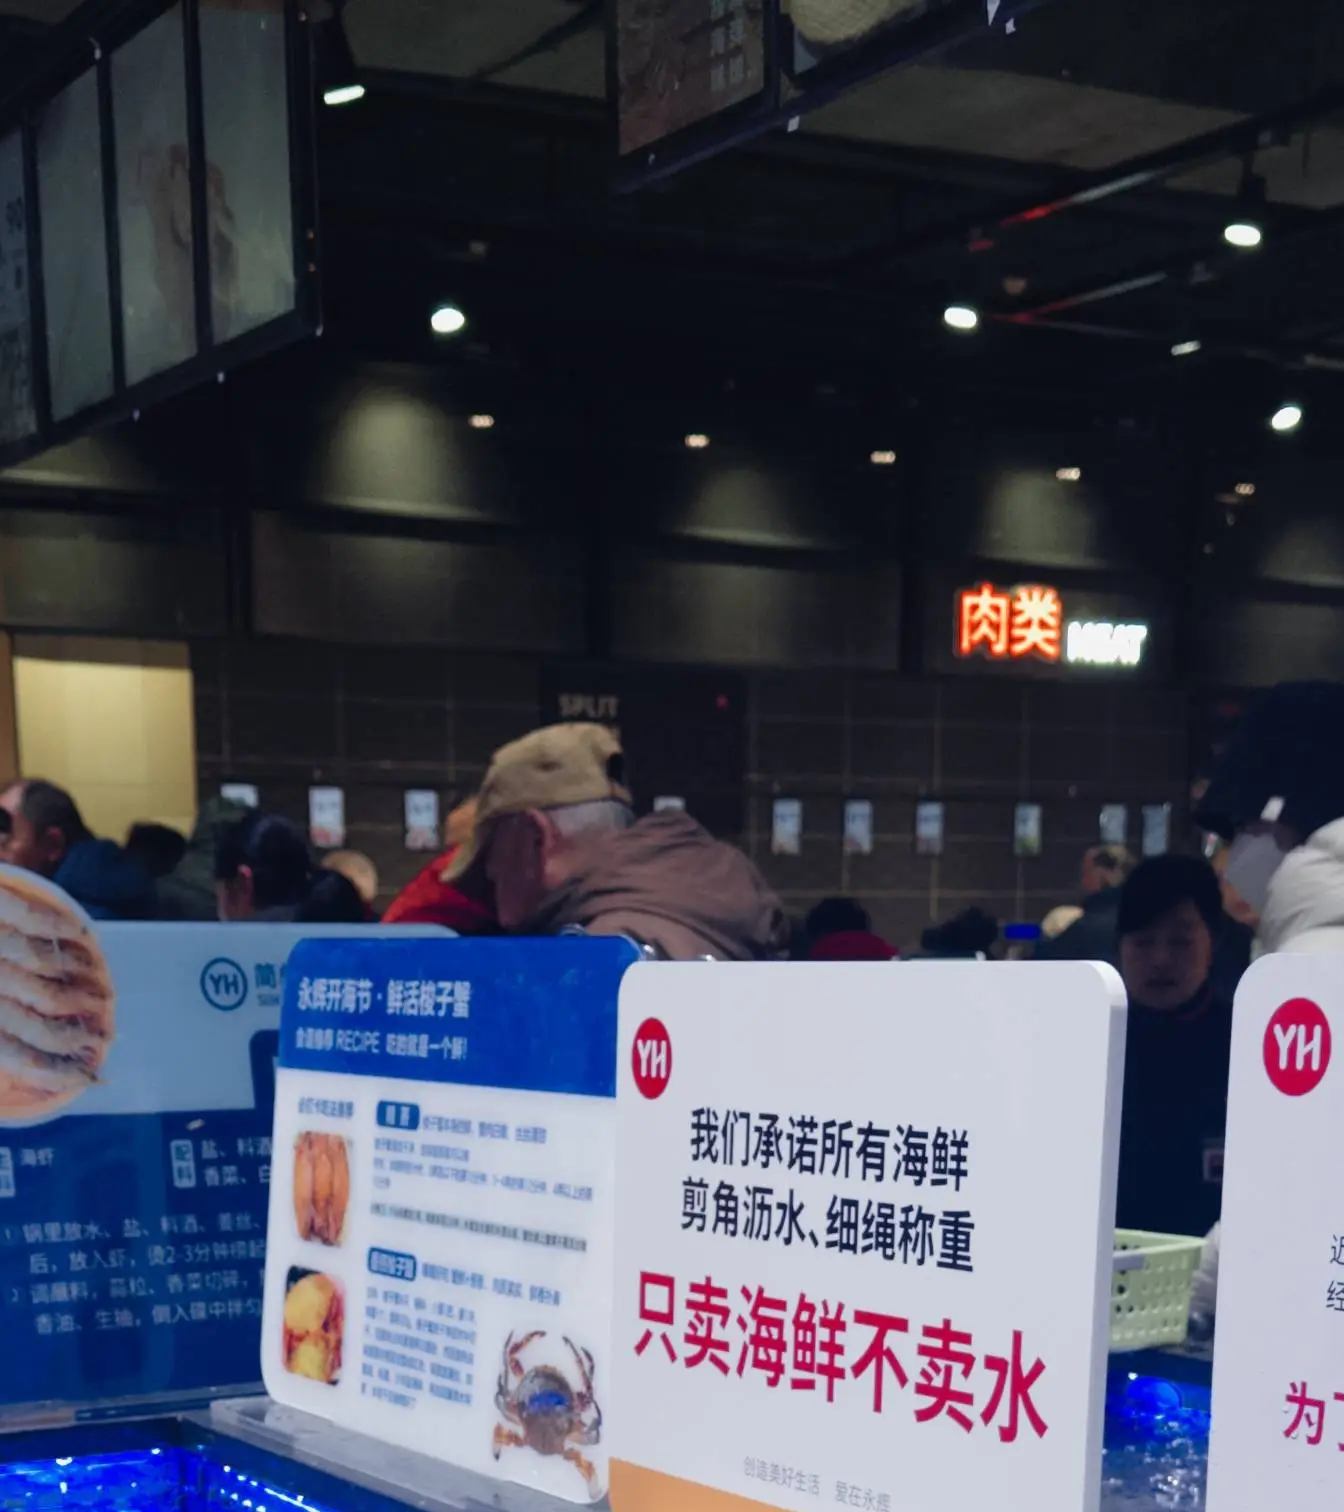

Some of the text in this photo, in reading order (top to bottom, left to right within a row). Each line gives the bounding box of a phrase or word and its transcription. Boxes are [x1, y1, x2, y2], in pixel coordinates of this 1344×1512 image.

[960, 582, 1060, 659] 肉类
[336, 1028, 381, 1055] RECIPE
[690, 1106, 970, 1191] 我们承诺所有海鲜
[681, 1176, 975, 1273] 剪角沥水、细绳称重
[633, 1270, 1049, 1443] 只卖海鲜不卖水
